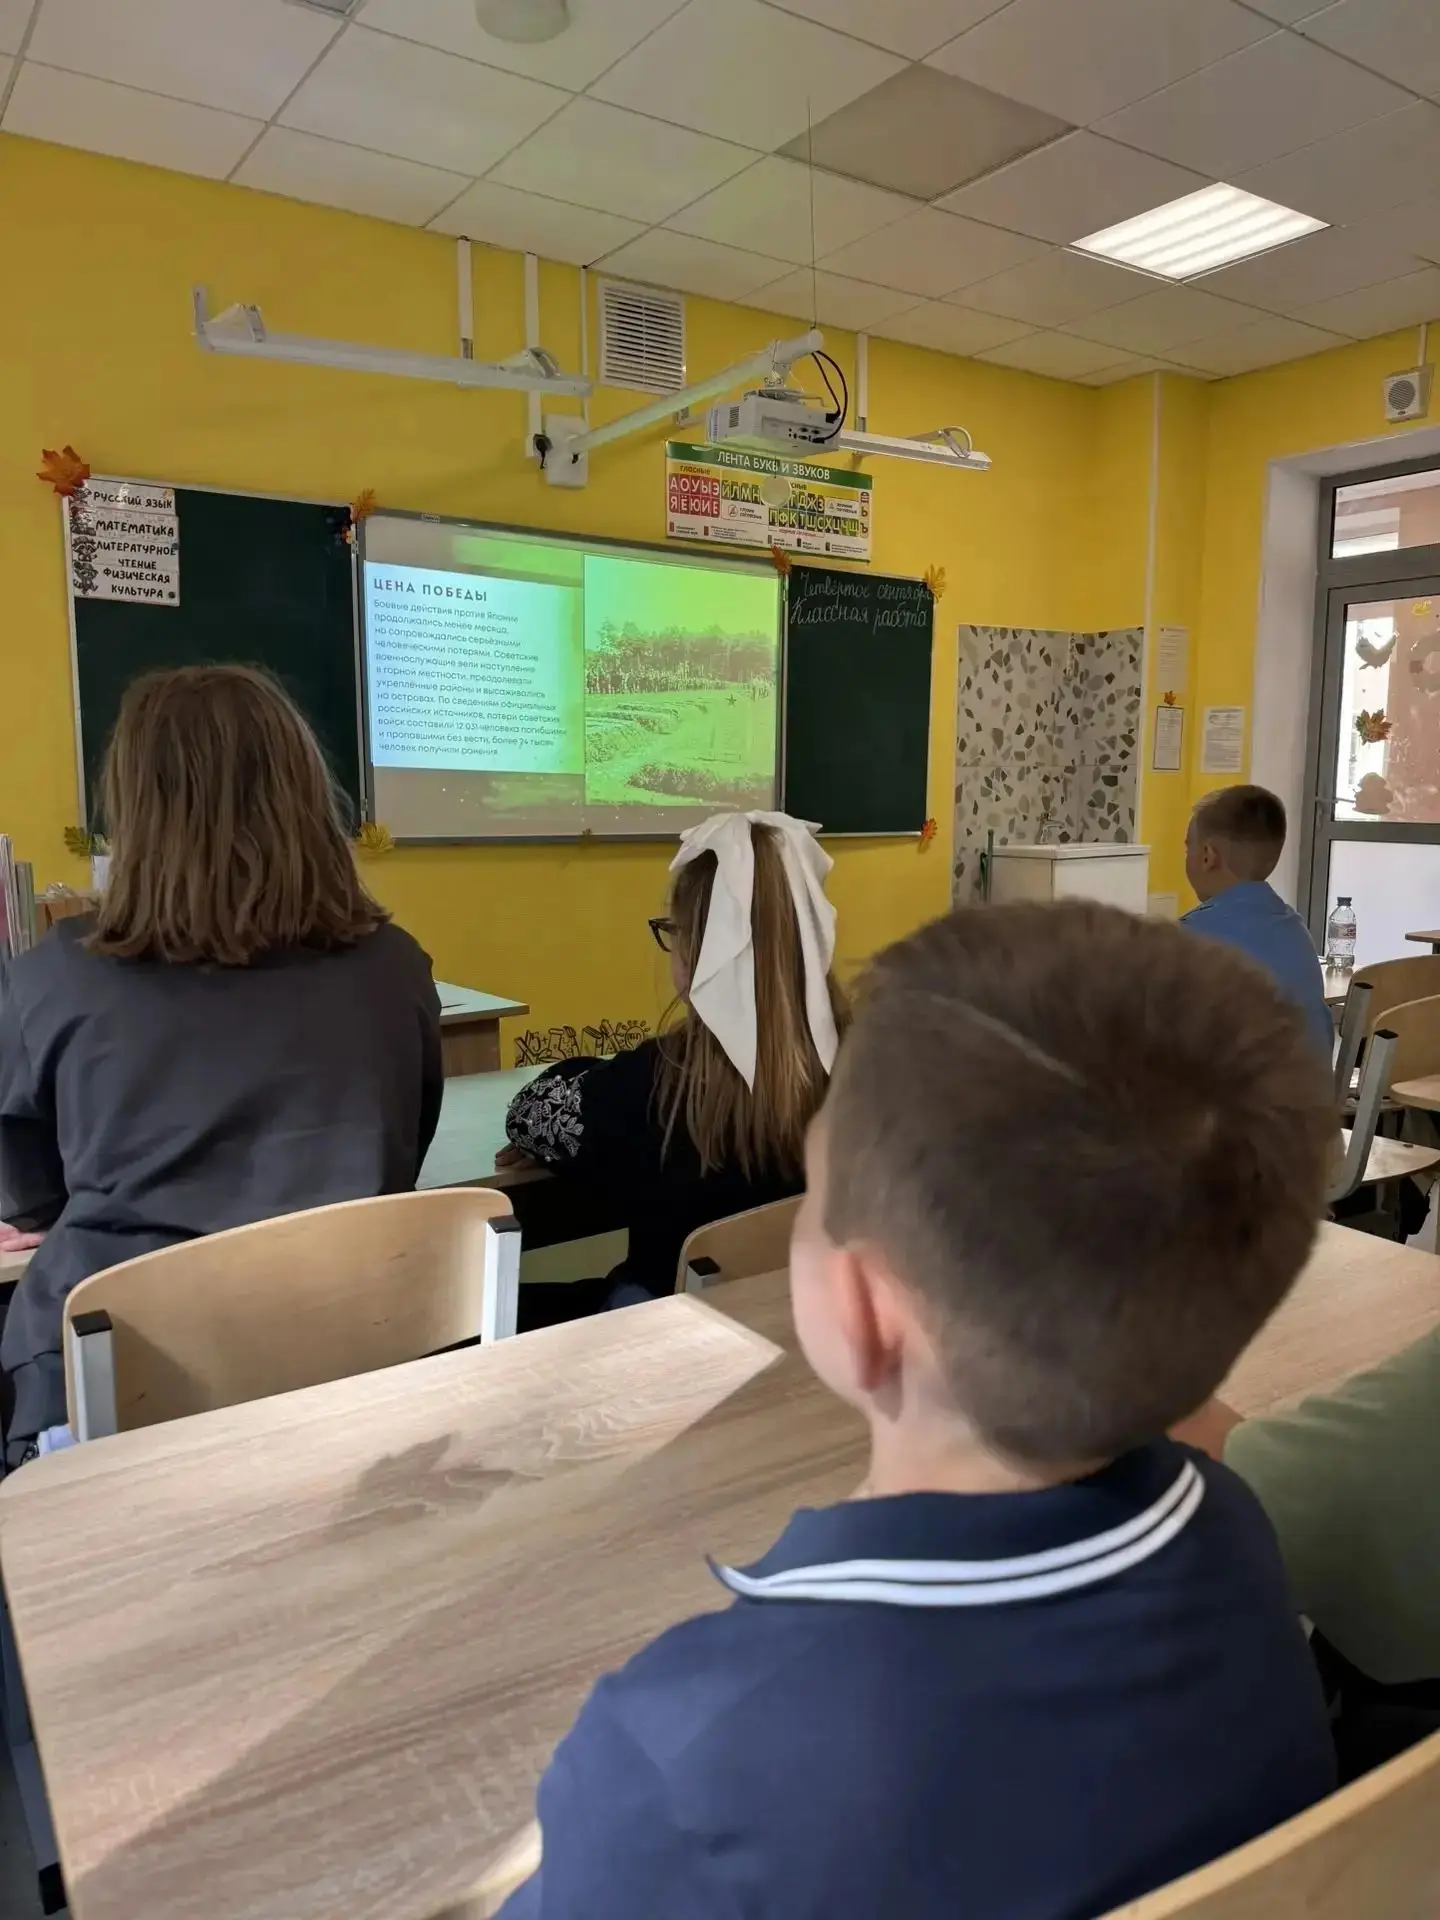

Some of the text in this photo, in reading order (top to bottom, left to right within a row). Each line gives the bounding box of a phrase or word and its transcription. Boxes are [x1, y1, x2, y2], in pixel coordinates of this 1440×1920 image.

[718, 452, 830, 480] ЛЕНТА БУКВ И ЗВУКОВ
[146, 499, 172, 509] ЯЗЫК
[96, 520, 174, 536] МАТЕМАТИКА
[96, 542, 176, 555] ЛИТЕРАТУРНОЕ
[118, 559, 156, 570] ЧТЕНИЕ
[104, 568, 170, 583] ФИЗИЧЕСКАЯ
[112, 585, 163, 598] КУЛЬТУРА
[374, 579, 487, 601] ЦЕНА ПОБЕДЫ
[374, 600, 409, 611] Боевые
[410, 603, 453, 615] действия
[454, 609, 485, 620] против
[791, 597, 927, 635] Классная работа
[374, 613, 443, 627] продолжались
[444, 621, 473, 629] менее
[384, 667, 416, 676] горной
[487, 713, 518, 721] потери
[407, 720, 454, 729] составили
